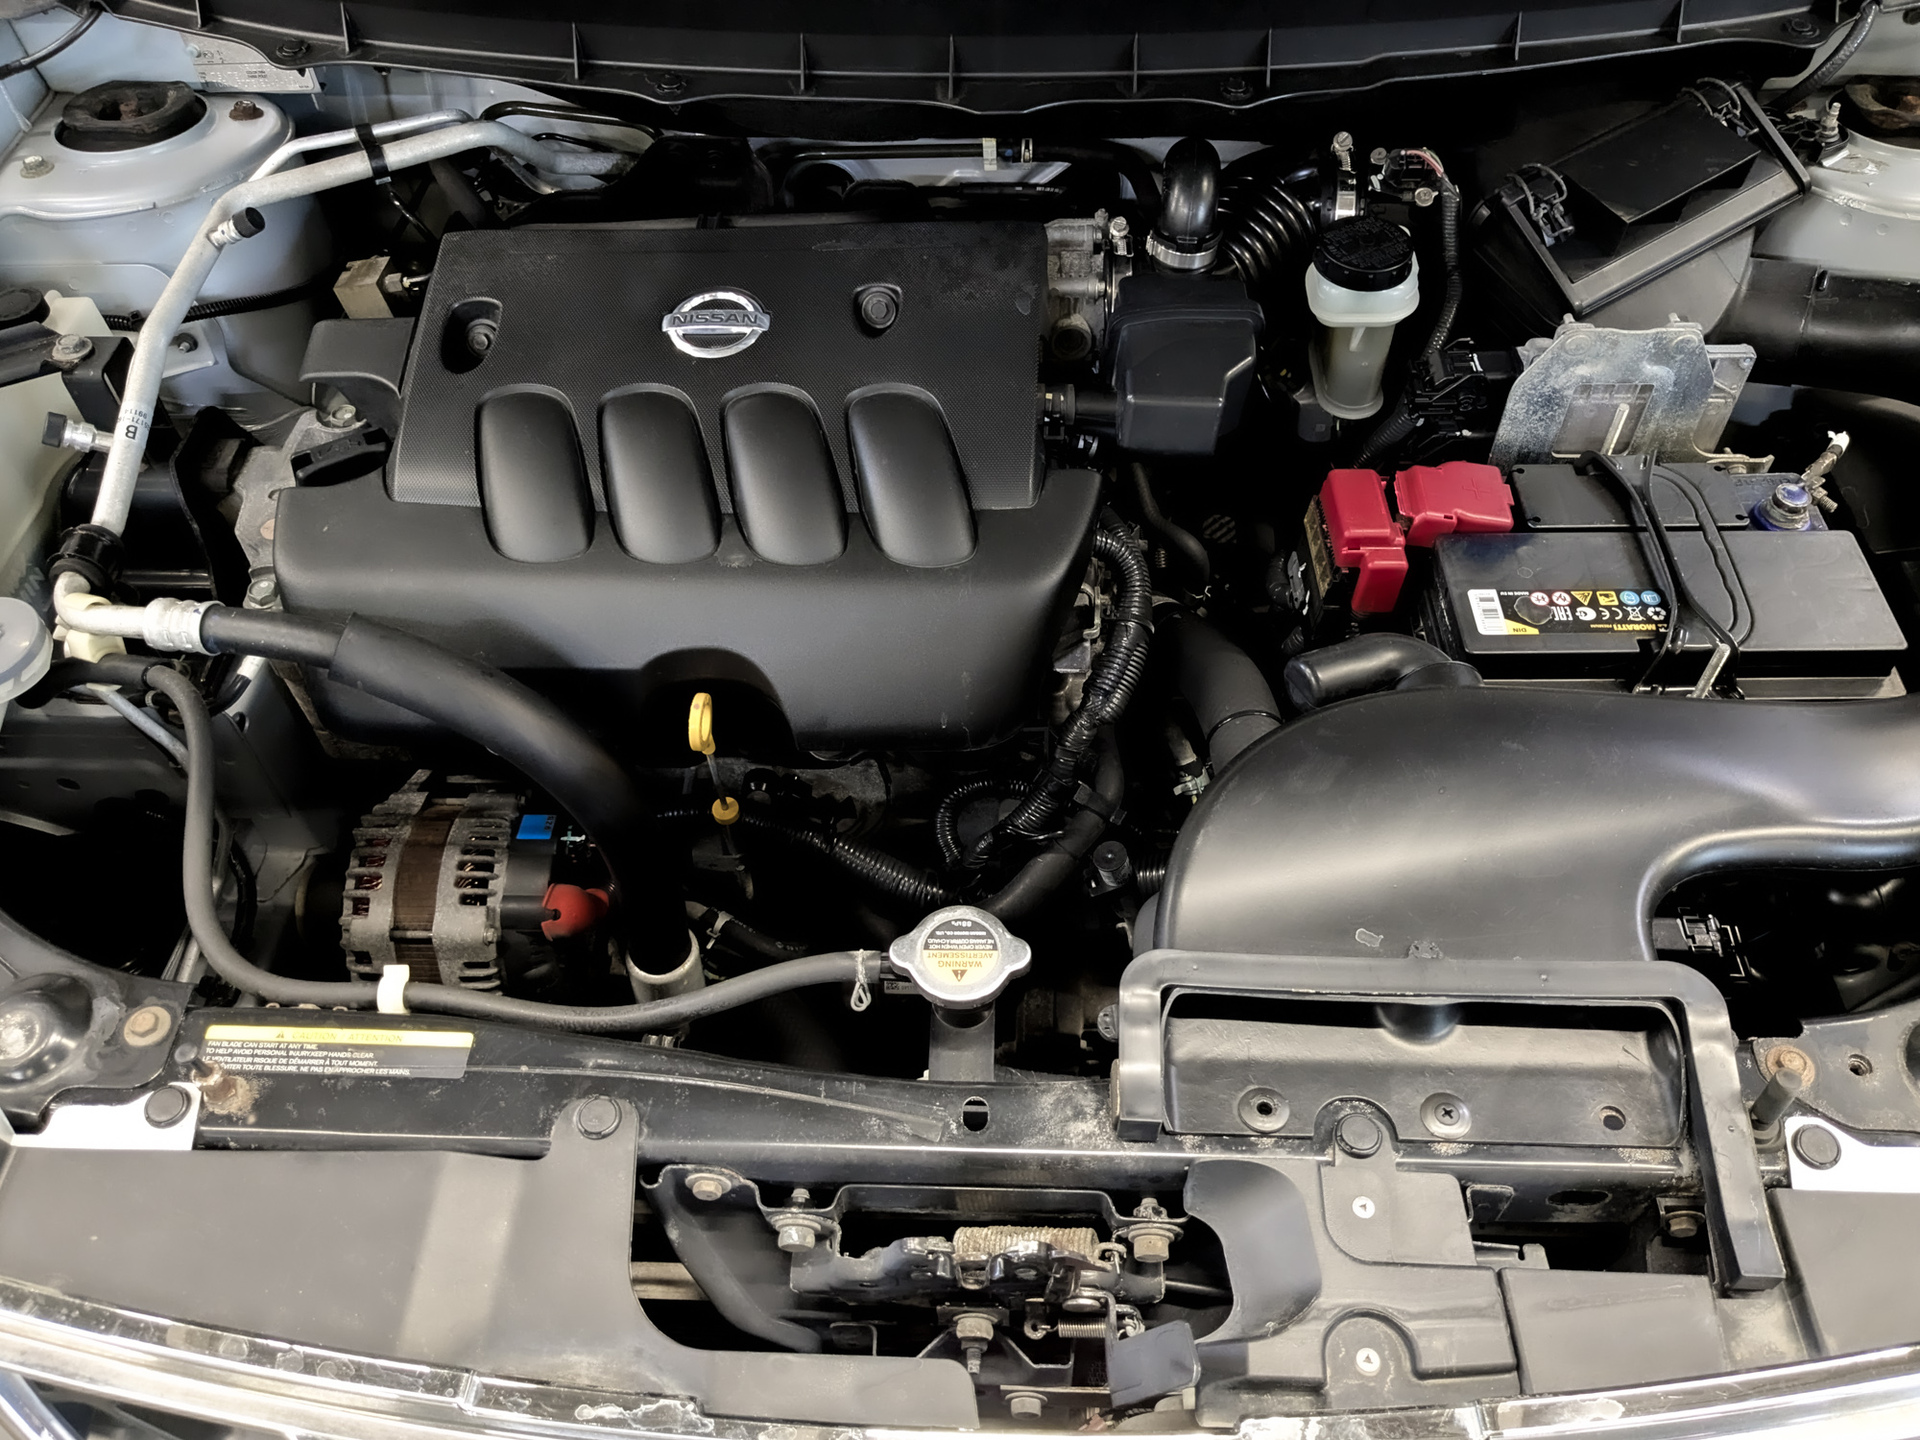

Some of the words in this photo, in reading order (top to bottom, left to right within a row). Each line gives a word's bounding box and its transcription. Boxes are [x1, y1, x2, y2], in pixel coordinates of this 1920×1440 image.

[672, 312, 758, 326] NISSAN
[125, 424, 138, 440] B
[1550, 606, 1574, 621] EAC
[1613, 623, 1656, 631] MORATTI
[938, 960, 983, 968] WARNING
[292, 1031, 337, 1040] CAUTION
[348, 1033, 403, 1042] ATTENTION
[289, 1057, 325, 1065] DÉMARRER
